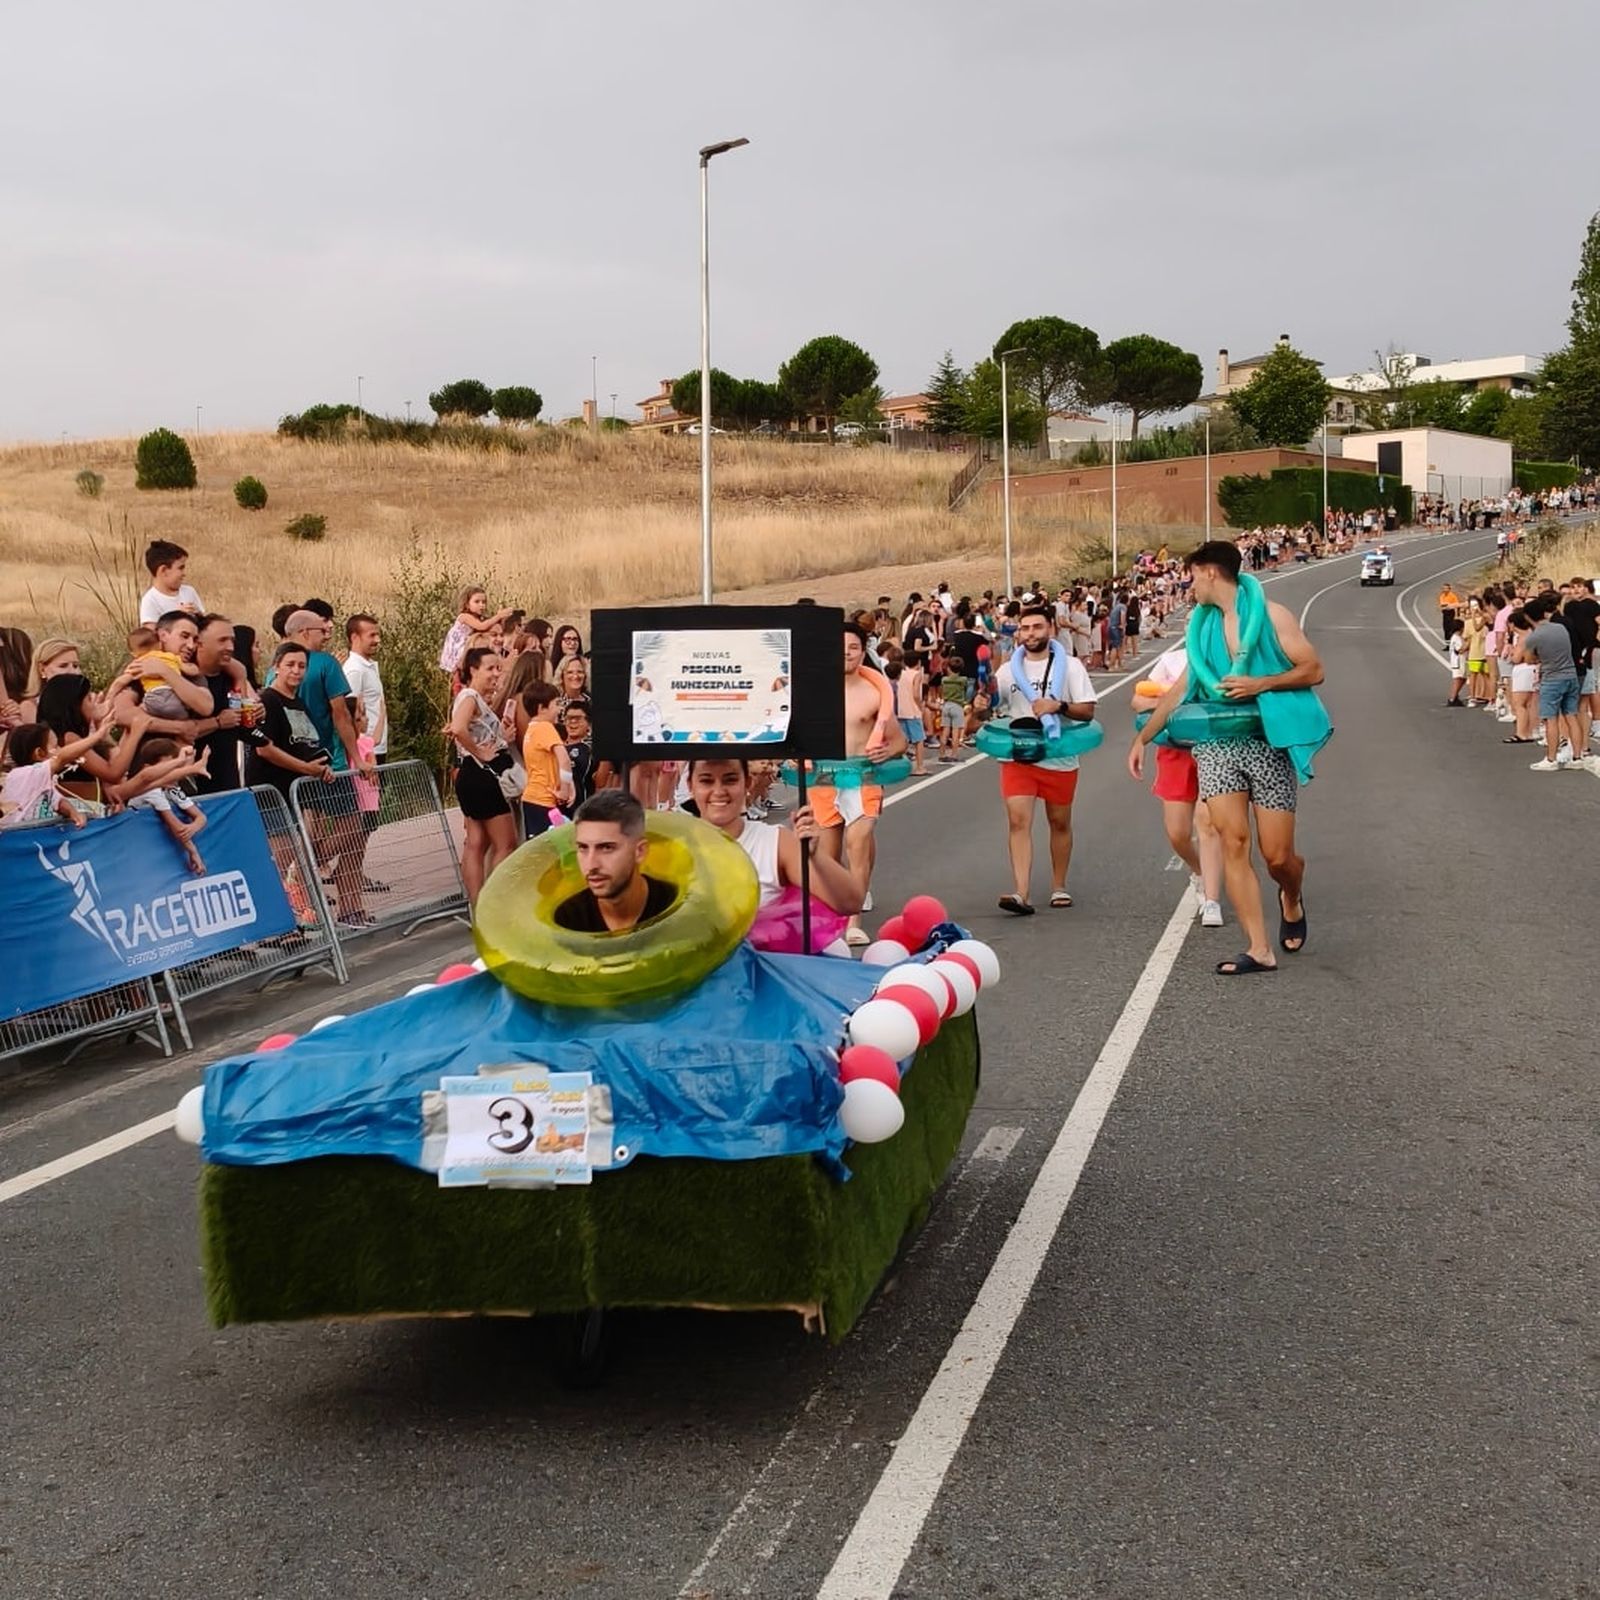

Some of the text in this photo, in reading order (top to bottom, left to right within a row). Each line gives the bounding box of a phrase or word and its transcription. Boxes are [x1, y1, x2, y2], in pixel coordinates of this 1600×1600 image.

[692, 651, 731, 660] NUEVAS
[681, 664, 742, 675] PISCINAS
[670, 679, 754, 691] MUNICIPALES
[486, 1096, 534, 1154] 3
